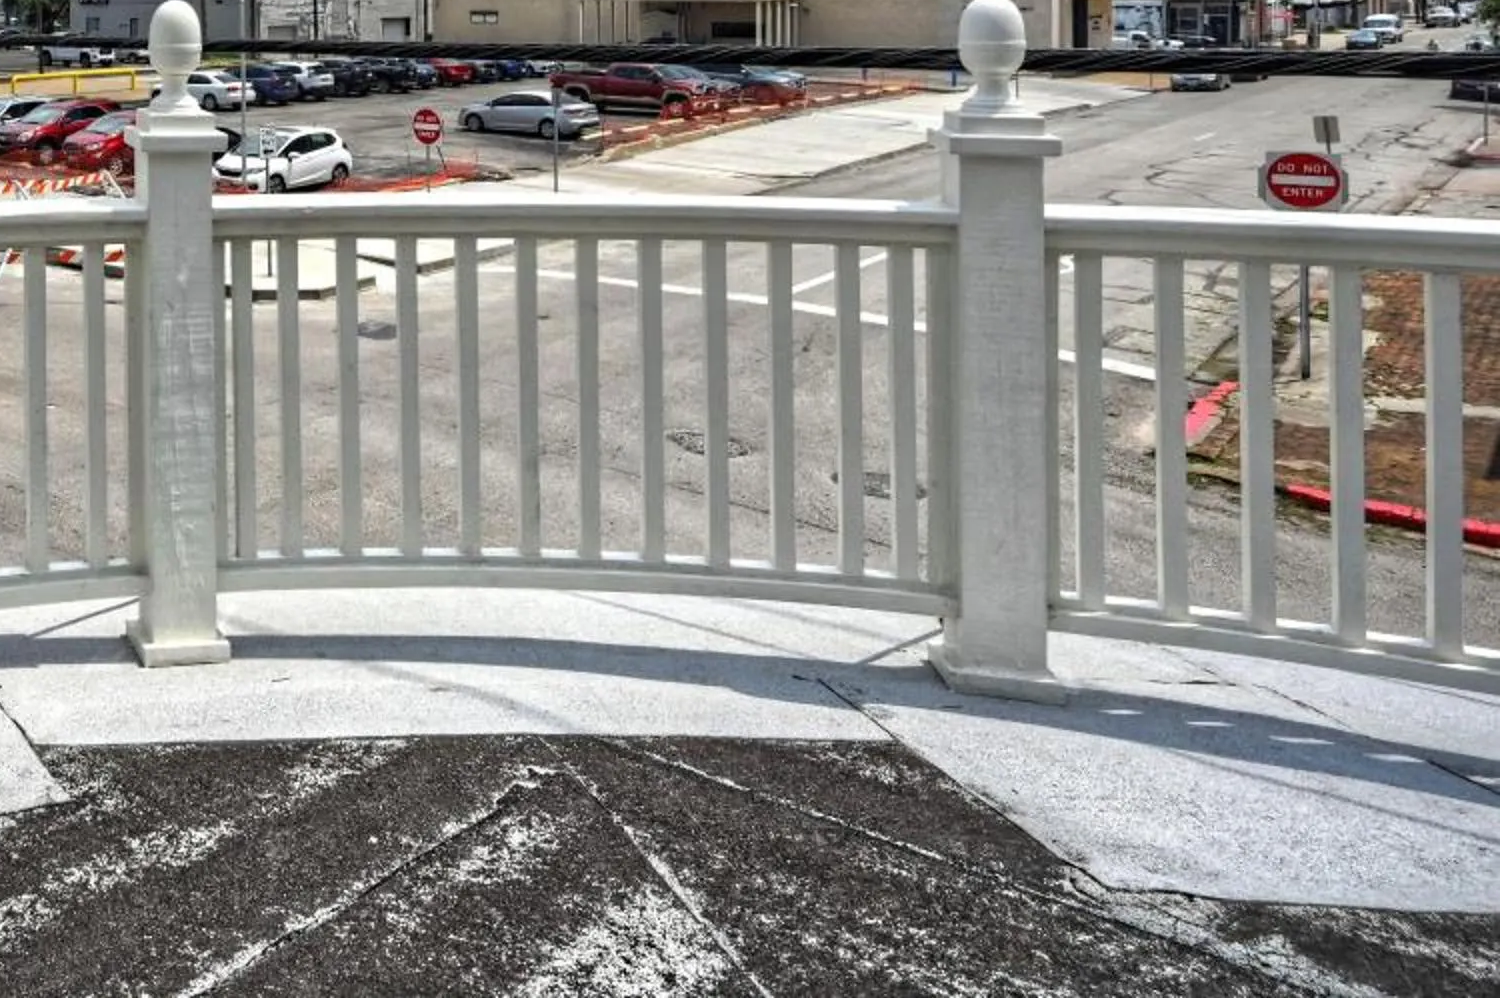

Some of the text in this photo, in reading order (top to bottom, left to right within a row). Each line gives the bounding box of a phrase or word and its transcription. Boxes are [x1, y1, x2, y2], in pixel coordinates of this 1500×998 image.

[1277, 162, 1328, 174] DO NOT
[1282, 187, 1324, 198] ENTER
